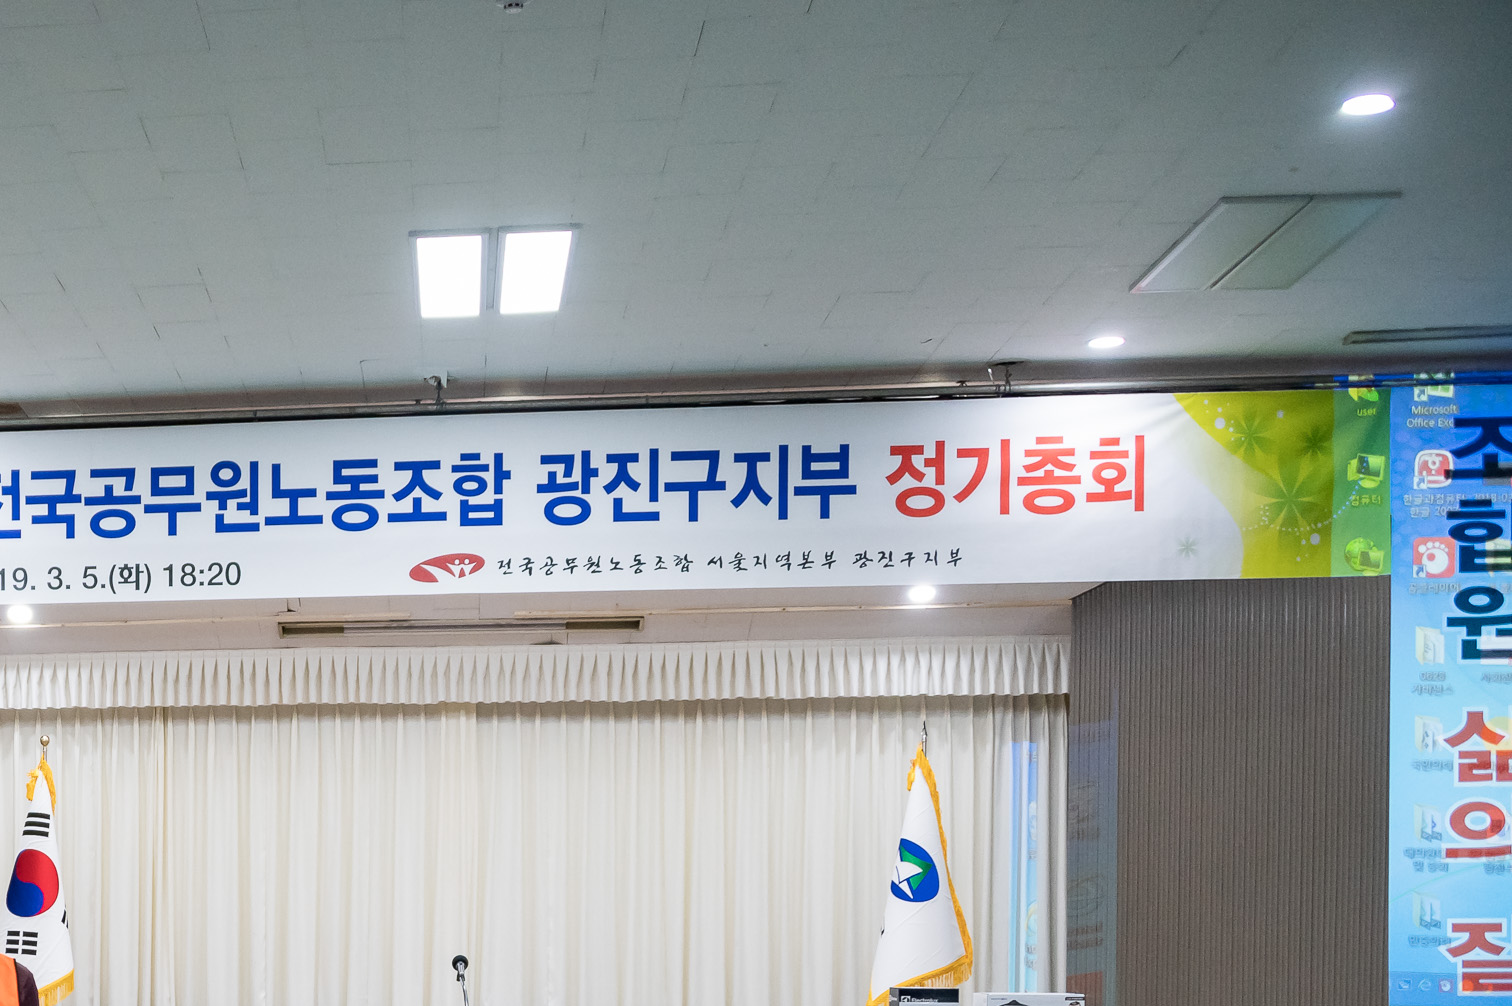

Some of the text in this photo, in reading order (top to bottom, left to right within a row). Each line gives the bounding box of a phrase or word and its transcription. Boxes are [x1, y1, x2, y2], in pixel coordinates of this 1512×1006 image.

[1356, 408, 1377, 417] user
[1411, 404, 1458, 415] Microsoft
[1406, 417, 1436, 428] Office
[536, 443, 858, 527] 광진구지부
[885, 434, 1146, 519] 정기총회
[497, 547, 964, 577] 전국공무원노동조합 서울지역본부 광진구지부
[46, 566, 72, 591] 3.
[82, 562, 153, 595] 5.(화)
[163, 560, 243, 589] 18:20
